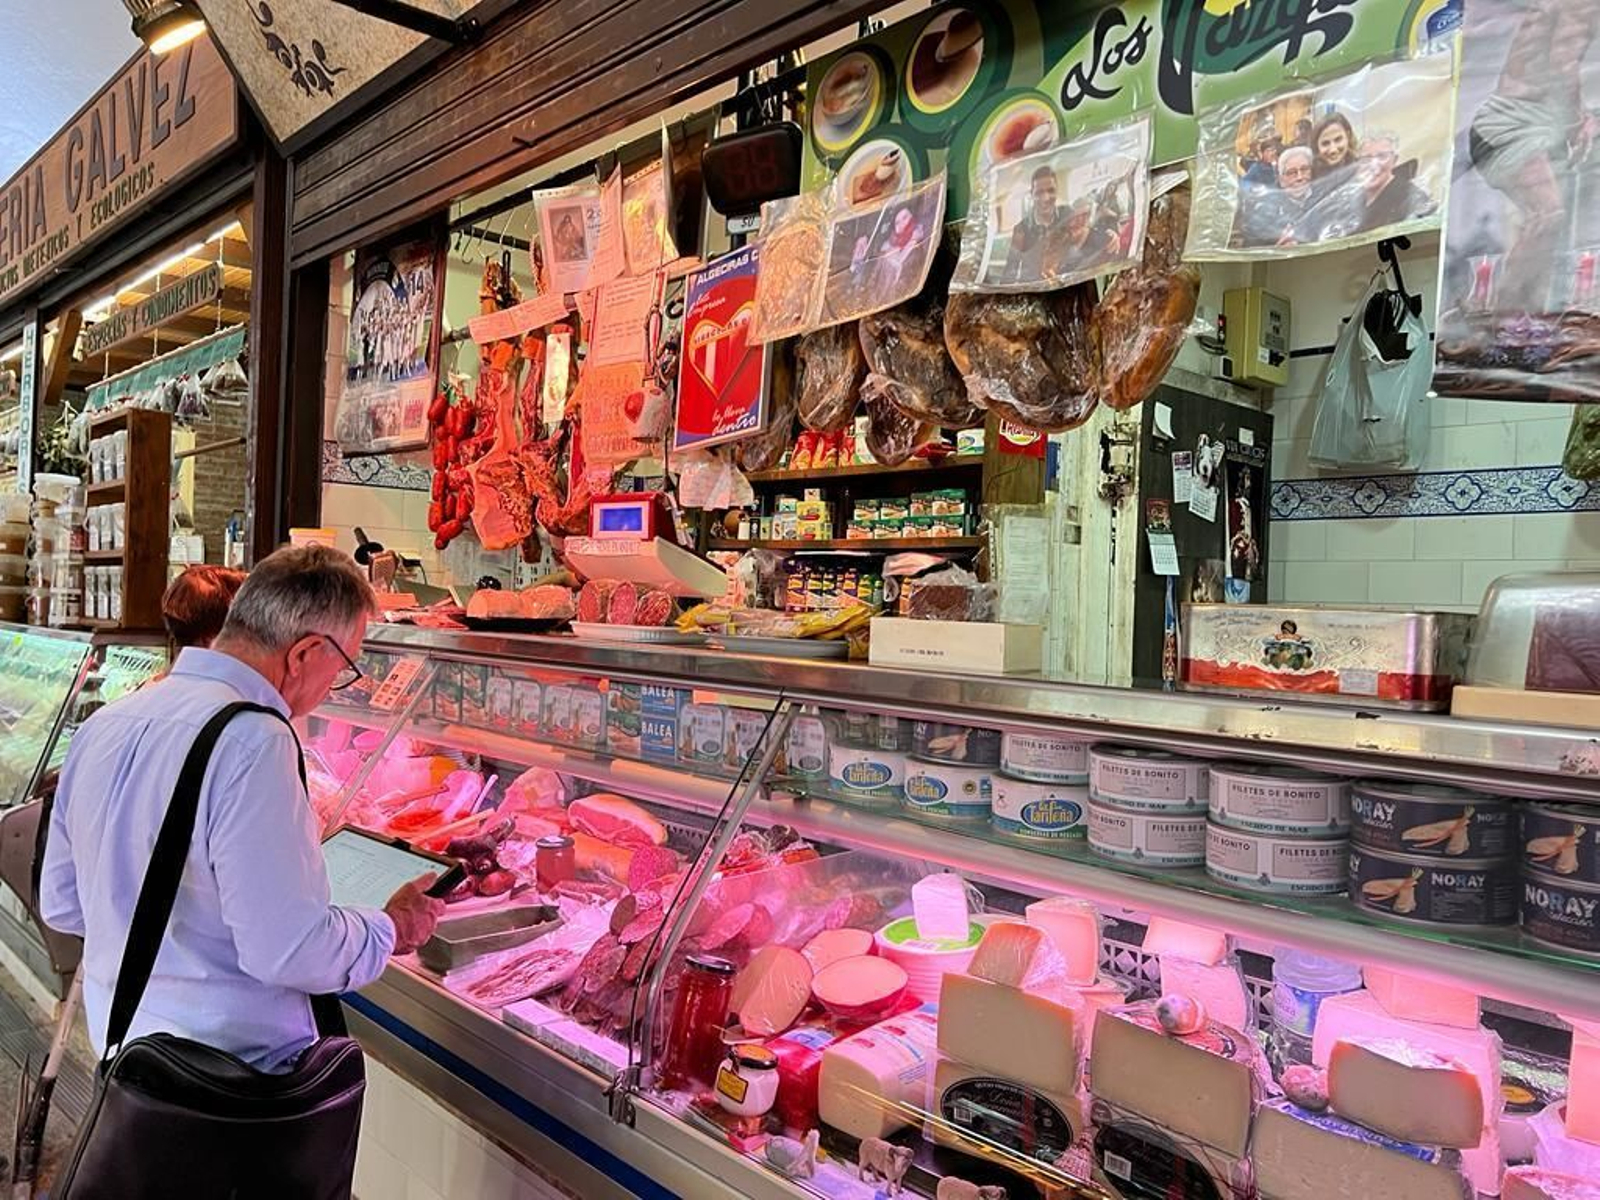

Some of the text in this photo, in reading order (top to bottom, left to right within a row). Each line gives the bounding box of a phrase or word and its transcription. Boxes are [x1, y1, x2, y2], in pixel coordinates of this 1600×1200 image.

[1061, 8, 1153, 111] Los
[65, 46, 196, 214] GALVEZ
[697, 253, 749, 287] ALGECIRAS
[641, 720, 673, 739] BALEA
[1102, 764, 1179, 780] FILETES DE BONITO
[1232, 784, 1321, 800] FILETES DE BONITO
[1221, 838, 1251, 851] BONITO
[1280, 848, 1317, 857] FILETES
[1431, 872, 1486, 888] NORAY
[1525, 883, 1599, 918] NORAY
